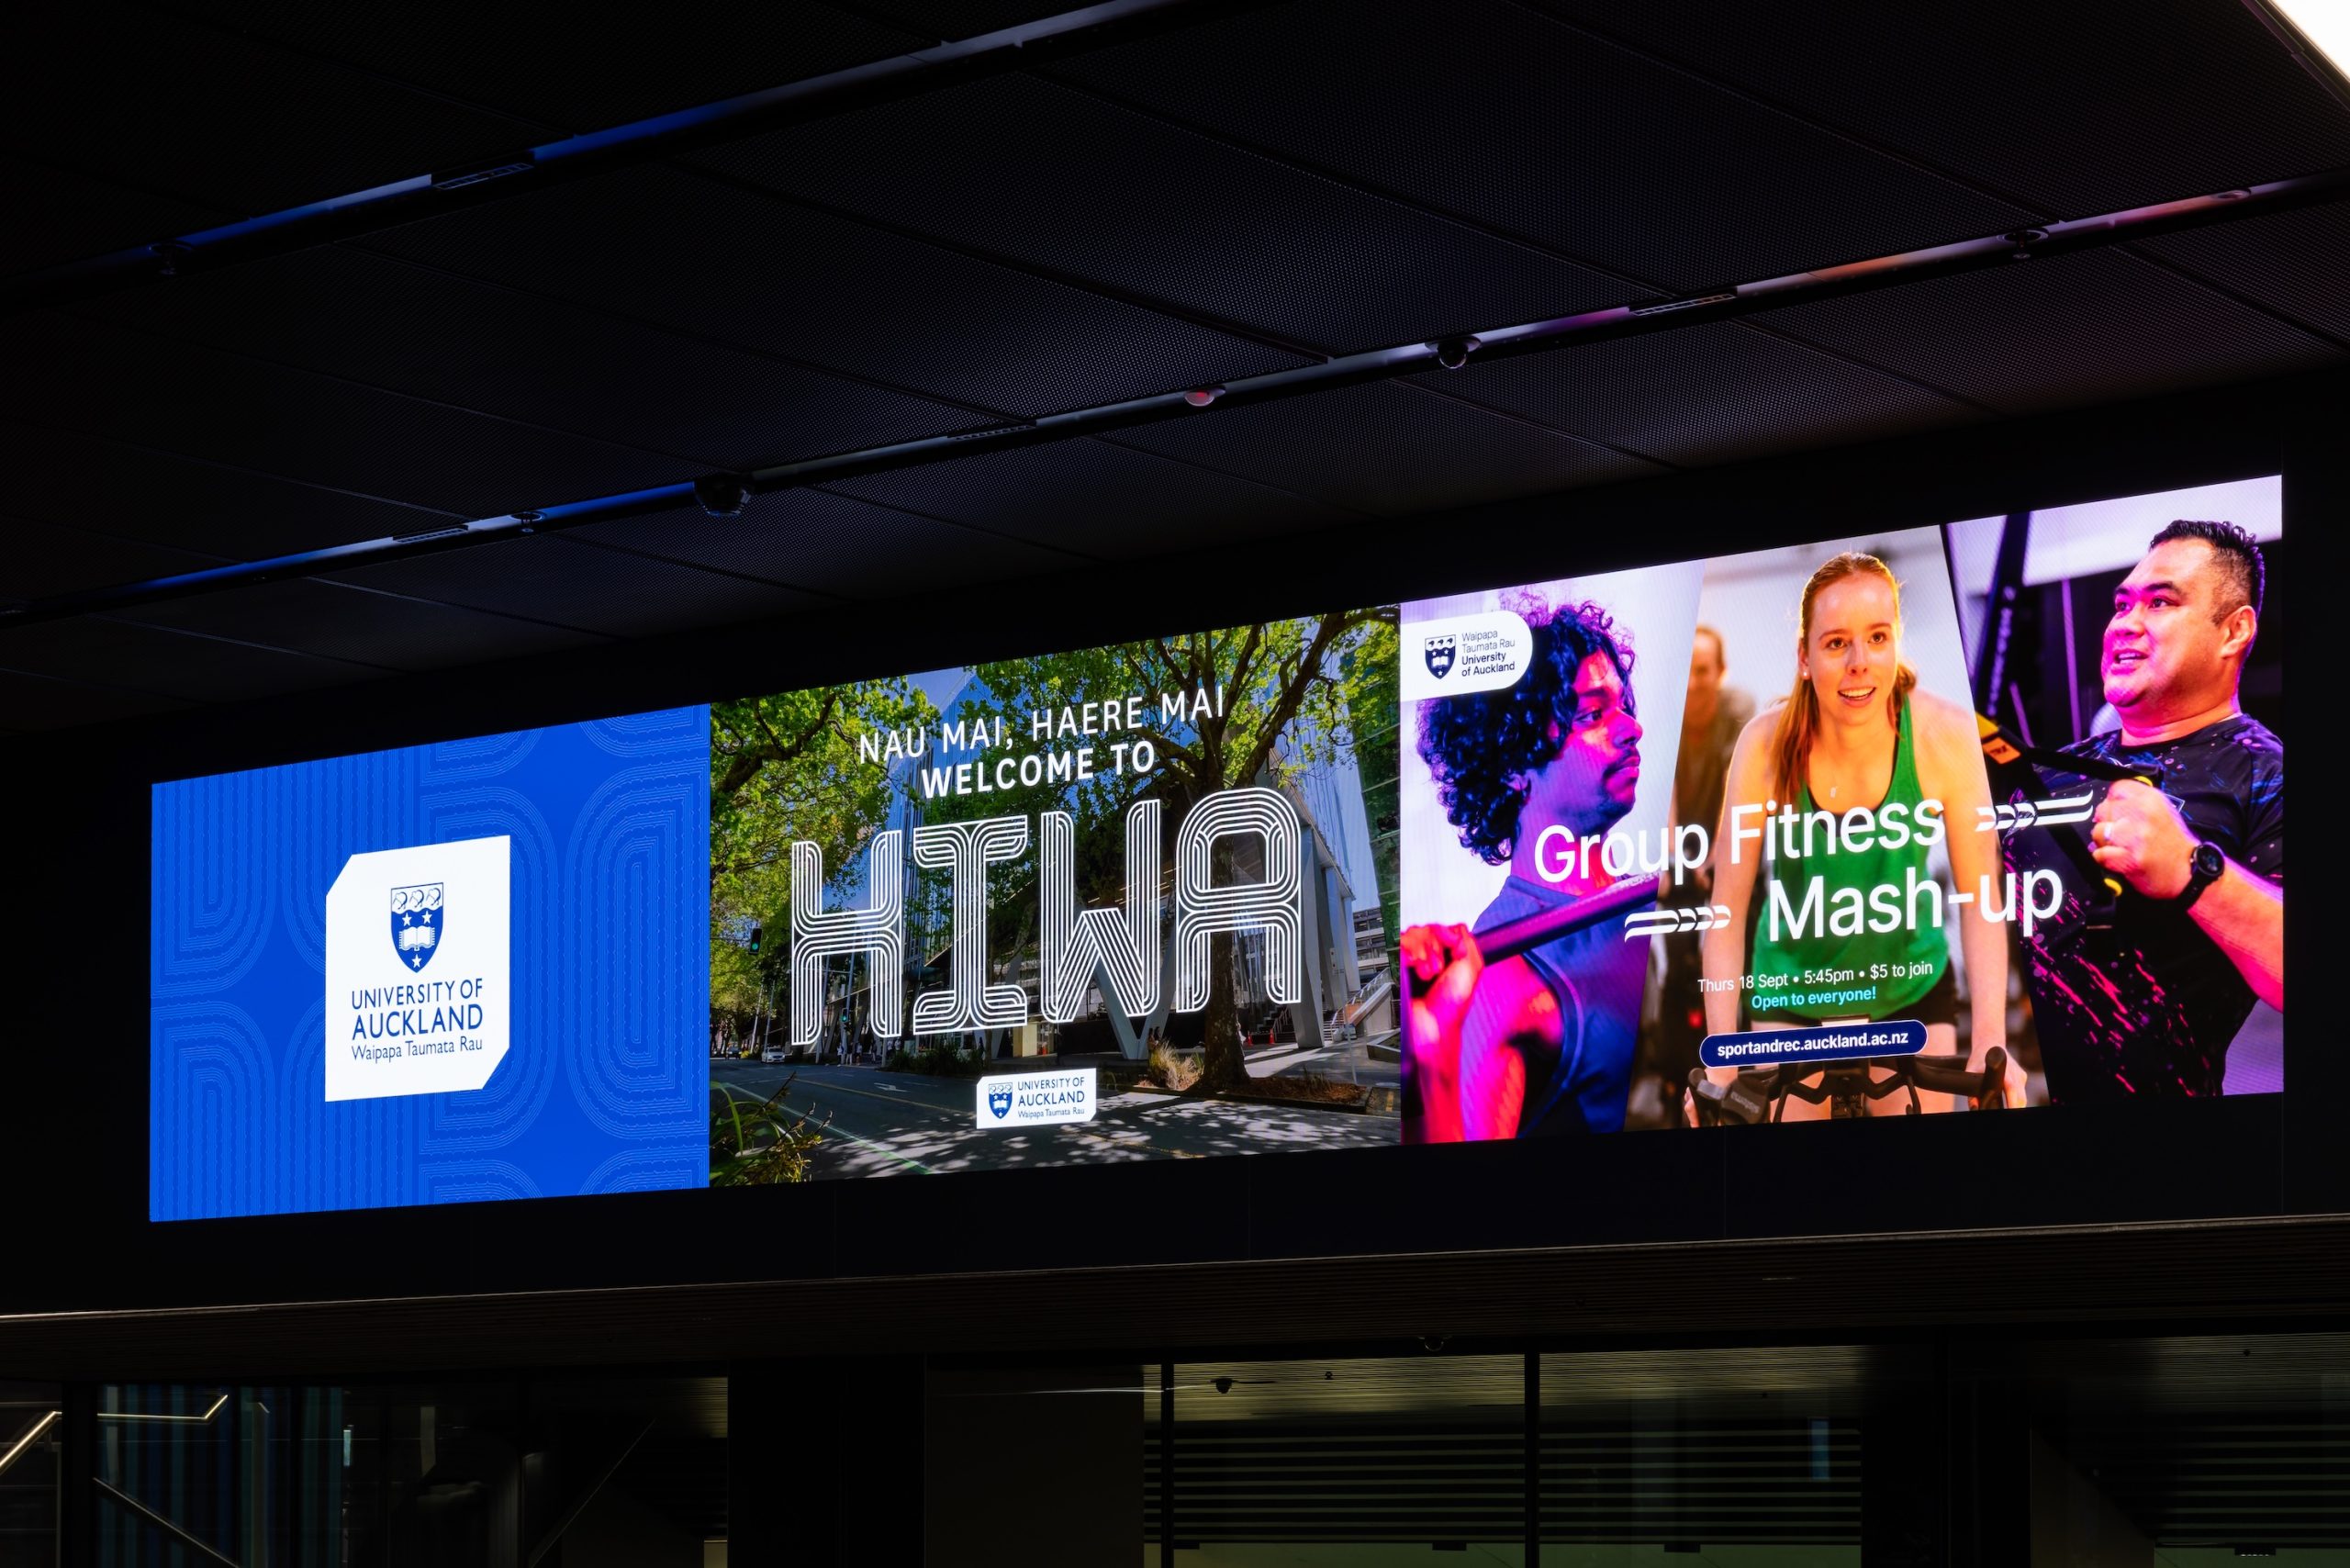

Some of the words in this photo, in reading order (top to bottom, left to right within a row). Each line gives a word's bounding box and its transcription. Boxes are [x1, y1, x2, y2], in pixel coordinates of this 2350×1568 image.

[1461, 630, 1498, 642] Waipapa
[1462, 640, 1498, 654] Taumata
[1499, 638, 1516, 648] Rau
[1461, 652, 1506, 666] University
[1461, 666, 1471, 677] of
[1472, 661, 1516, 676] Auckland
[859, 726, 925, 765] NAU
[942, 716, 1014, 751] MAI,
[1033, 696, 1143, 742] HAERE
[1161, 685, 1224, 723] MAI
[921, 745, 1094, 799] WELCOME
[1110, 739, 1156, 775] TO
[1534, 821, 1709, 887] Group
[1730, 798, 1946, 865] Fitness
[790, 786, 1302, 1046] HIWA
[1768, 867, 2064, 943] Mash-up
[1697, 977, 1734, 992] Thurs
[1740, 975, 1754, 990] 18
[1758, 972, 1789, 991] Sept
[1804, 968, 1854, 987] 5:45pm
[1870, 964, 1888, 980] $5
[1891, 963, 1906, 978] to
[1908, 959, 1933, 980] join
[352, 980, 455, 1010] UNIVERSITY
[460, 978, 483, 1000] OF
[1751, 994, 1788, 1011] Open
[1791, 991, 1805, 1006] to
[1807, 986, 1876, 1006] everyone!
[352, 1003, 483, 1041] AUCKLAND
[351, 1044, 402, 1064] Waipapa
[405, 1037, 454, 1057] Taumata
[460, 1036, 483, 1051] Rau
[1717, 1030, 1908, 1058] sportandrec.auckland.ac.nz
[1017, 1078, 1070, 1091] UNIVERSITY
[1072, 1076, 1085, 1087] OF
[1018, 1090, 1085, 1107] AUCKLAND
[1017, 1110, 1045, 1120] Waipapa
[1046, 1107, 1071, 1116] Taumata
[1072, 1106, 1085, 1114] Rau
